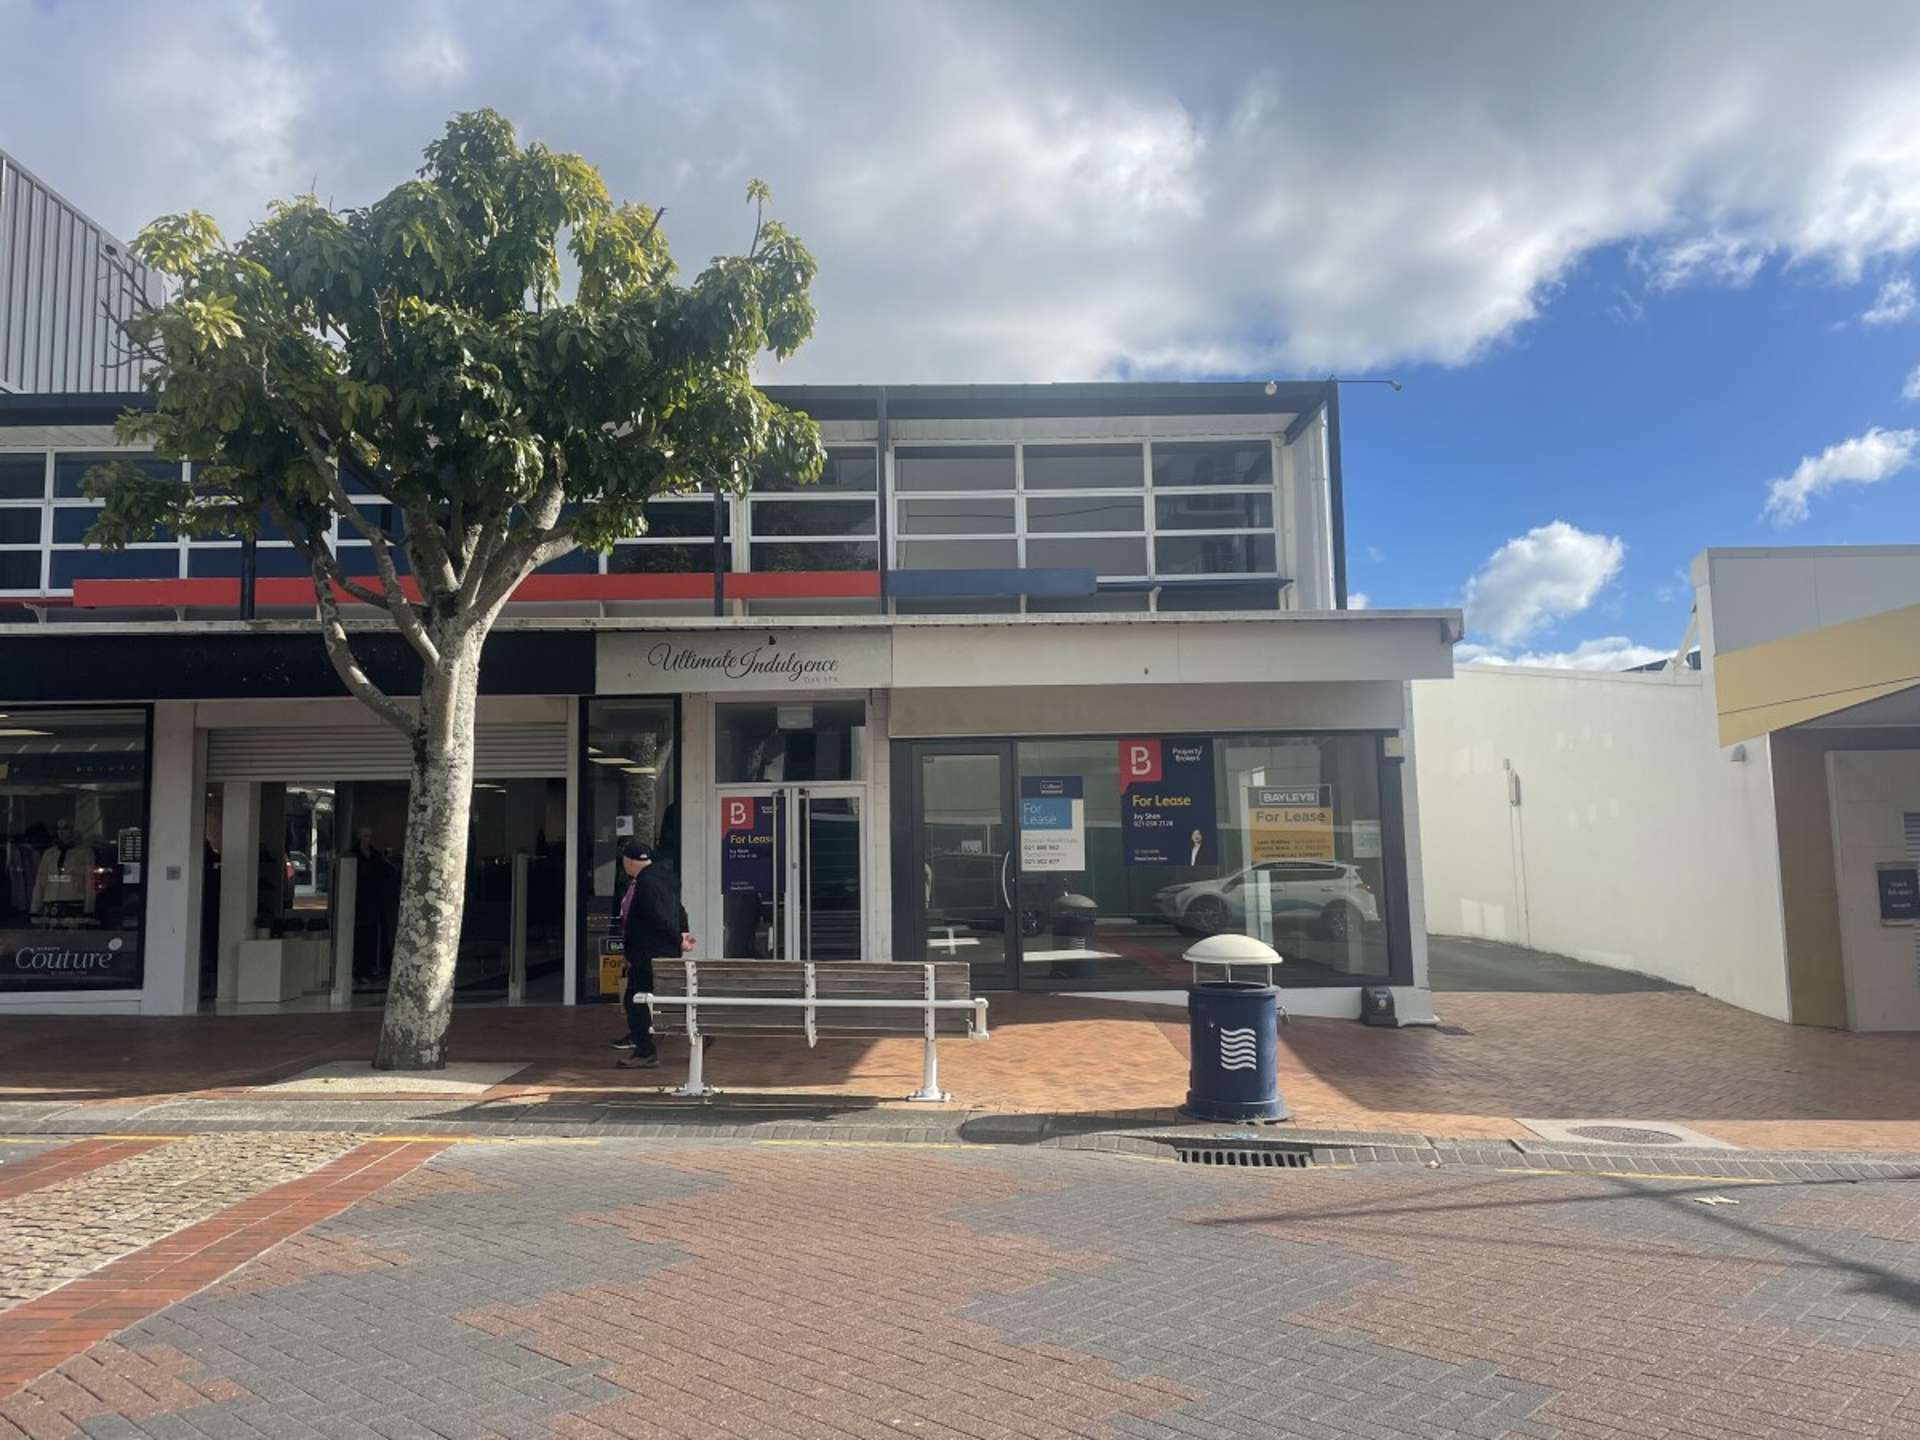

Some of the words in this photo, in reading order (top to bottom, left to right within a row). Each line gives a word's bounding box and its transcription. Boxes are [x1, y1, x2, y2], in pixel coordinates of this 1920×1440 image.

[648, 642, 738, 671] Ultimate
[724, 647, 839, 682] Indulgence
[1132, 795, 1152, 807] For
[1155, 795, 1191, 806] Lease
[1263, 793, 1316, 803] BAYLEYS
[1023, 802, 1041, 814] For
[1023, 815, 1057, 825] Lease
[1255, 811, 1280, 823] For
[1284, 811, 1327, 822] Lease
[730, 835, 747, 844] For
[15, 946, 113, 969] Couture
